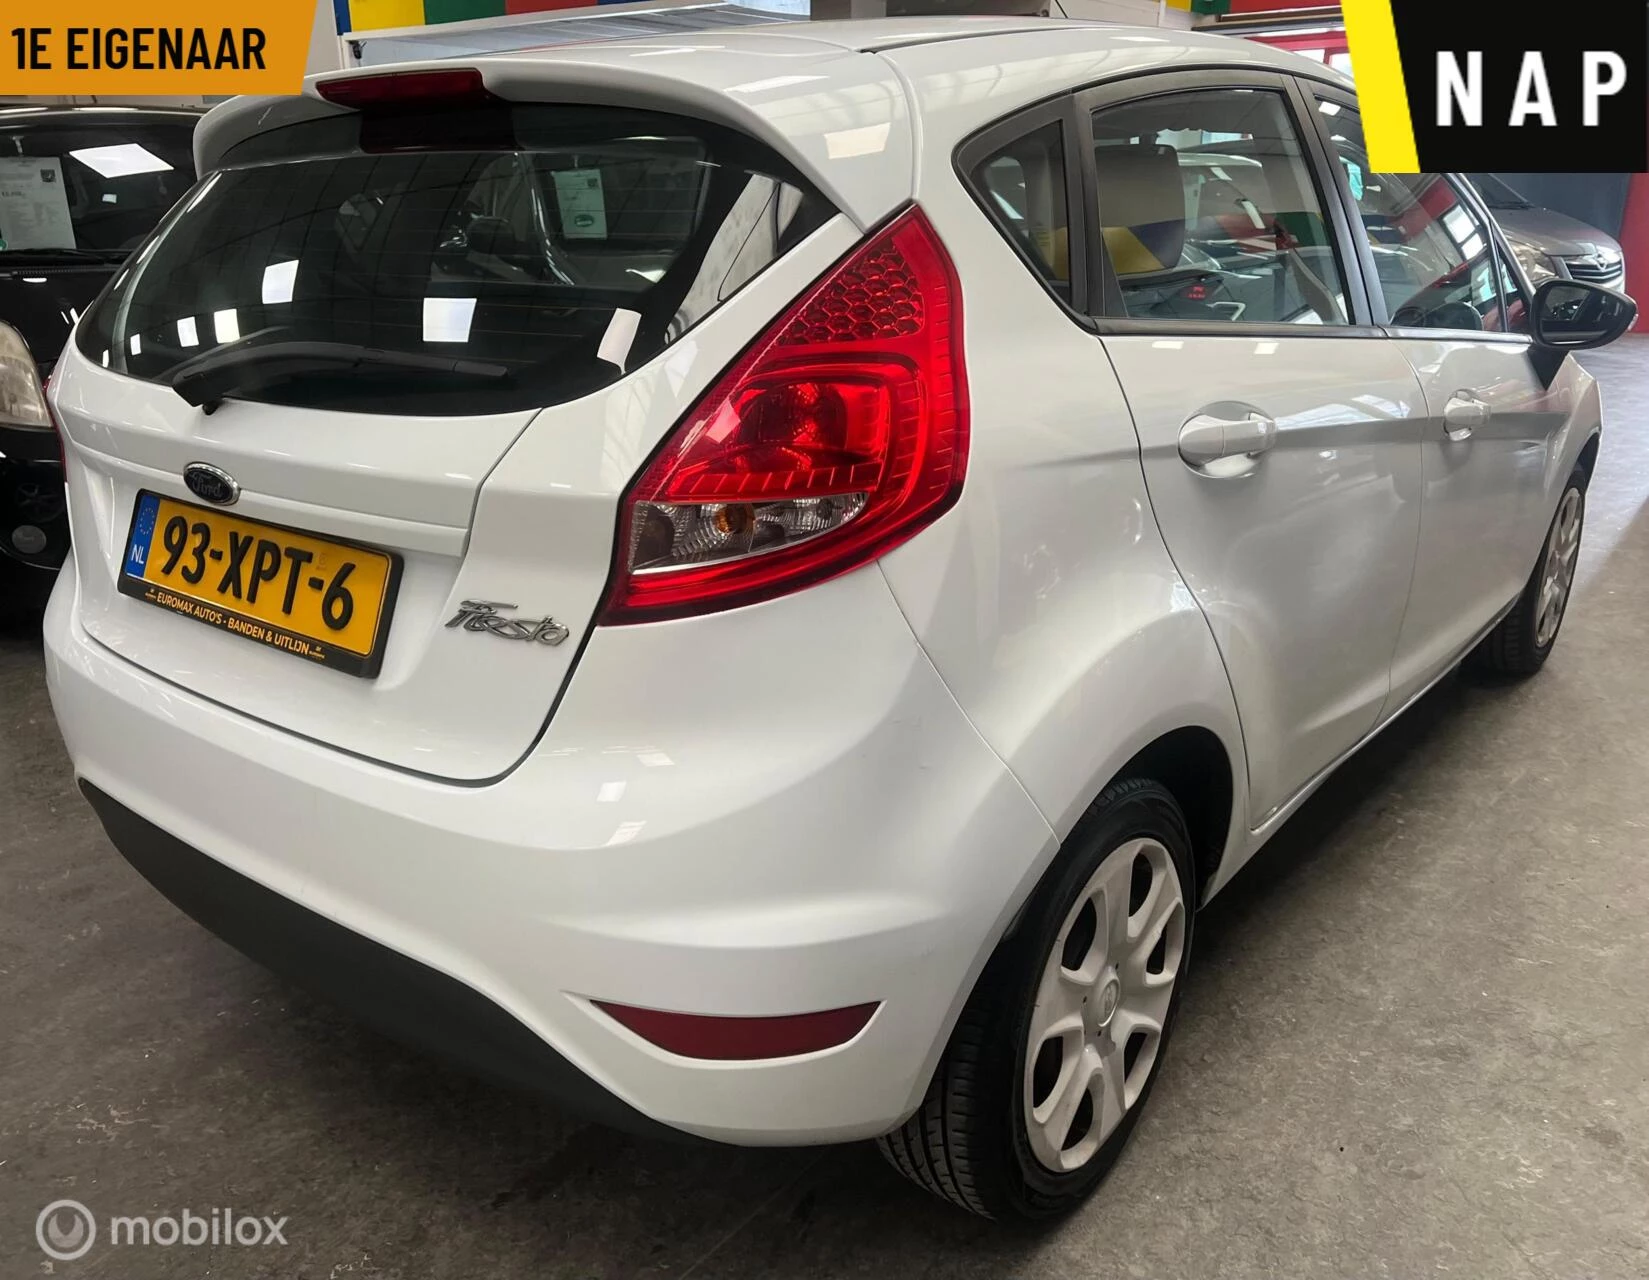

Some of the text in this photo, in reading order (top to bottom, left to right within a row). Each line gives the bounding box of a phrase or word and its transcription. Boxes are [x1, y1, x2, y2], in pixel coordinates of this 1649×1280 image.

[190, 471, 224, 498] Ford
[131, 544, 145, 565] NL
[161, 515, 356, 631] 93-XPT-6
[157, 592, 194, 614] EUROMAX
[194, 605, 222, 625] AUTO'S
[227, 617, 265, 640] BANDEN
[265, 630, 273, 642] &
[274, 633, 310, 655] UITLIJN
[444, 599, 570, 646] Fiesta
